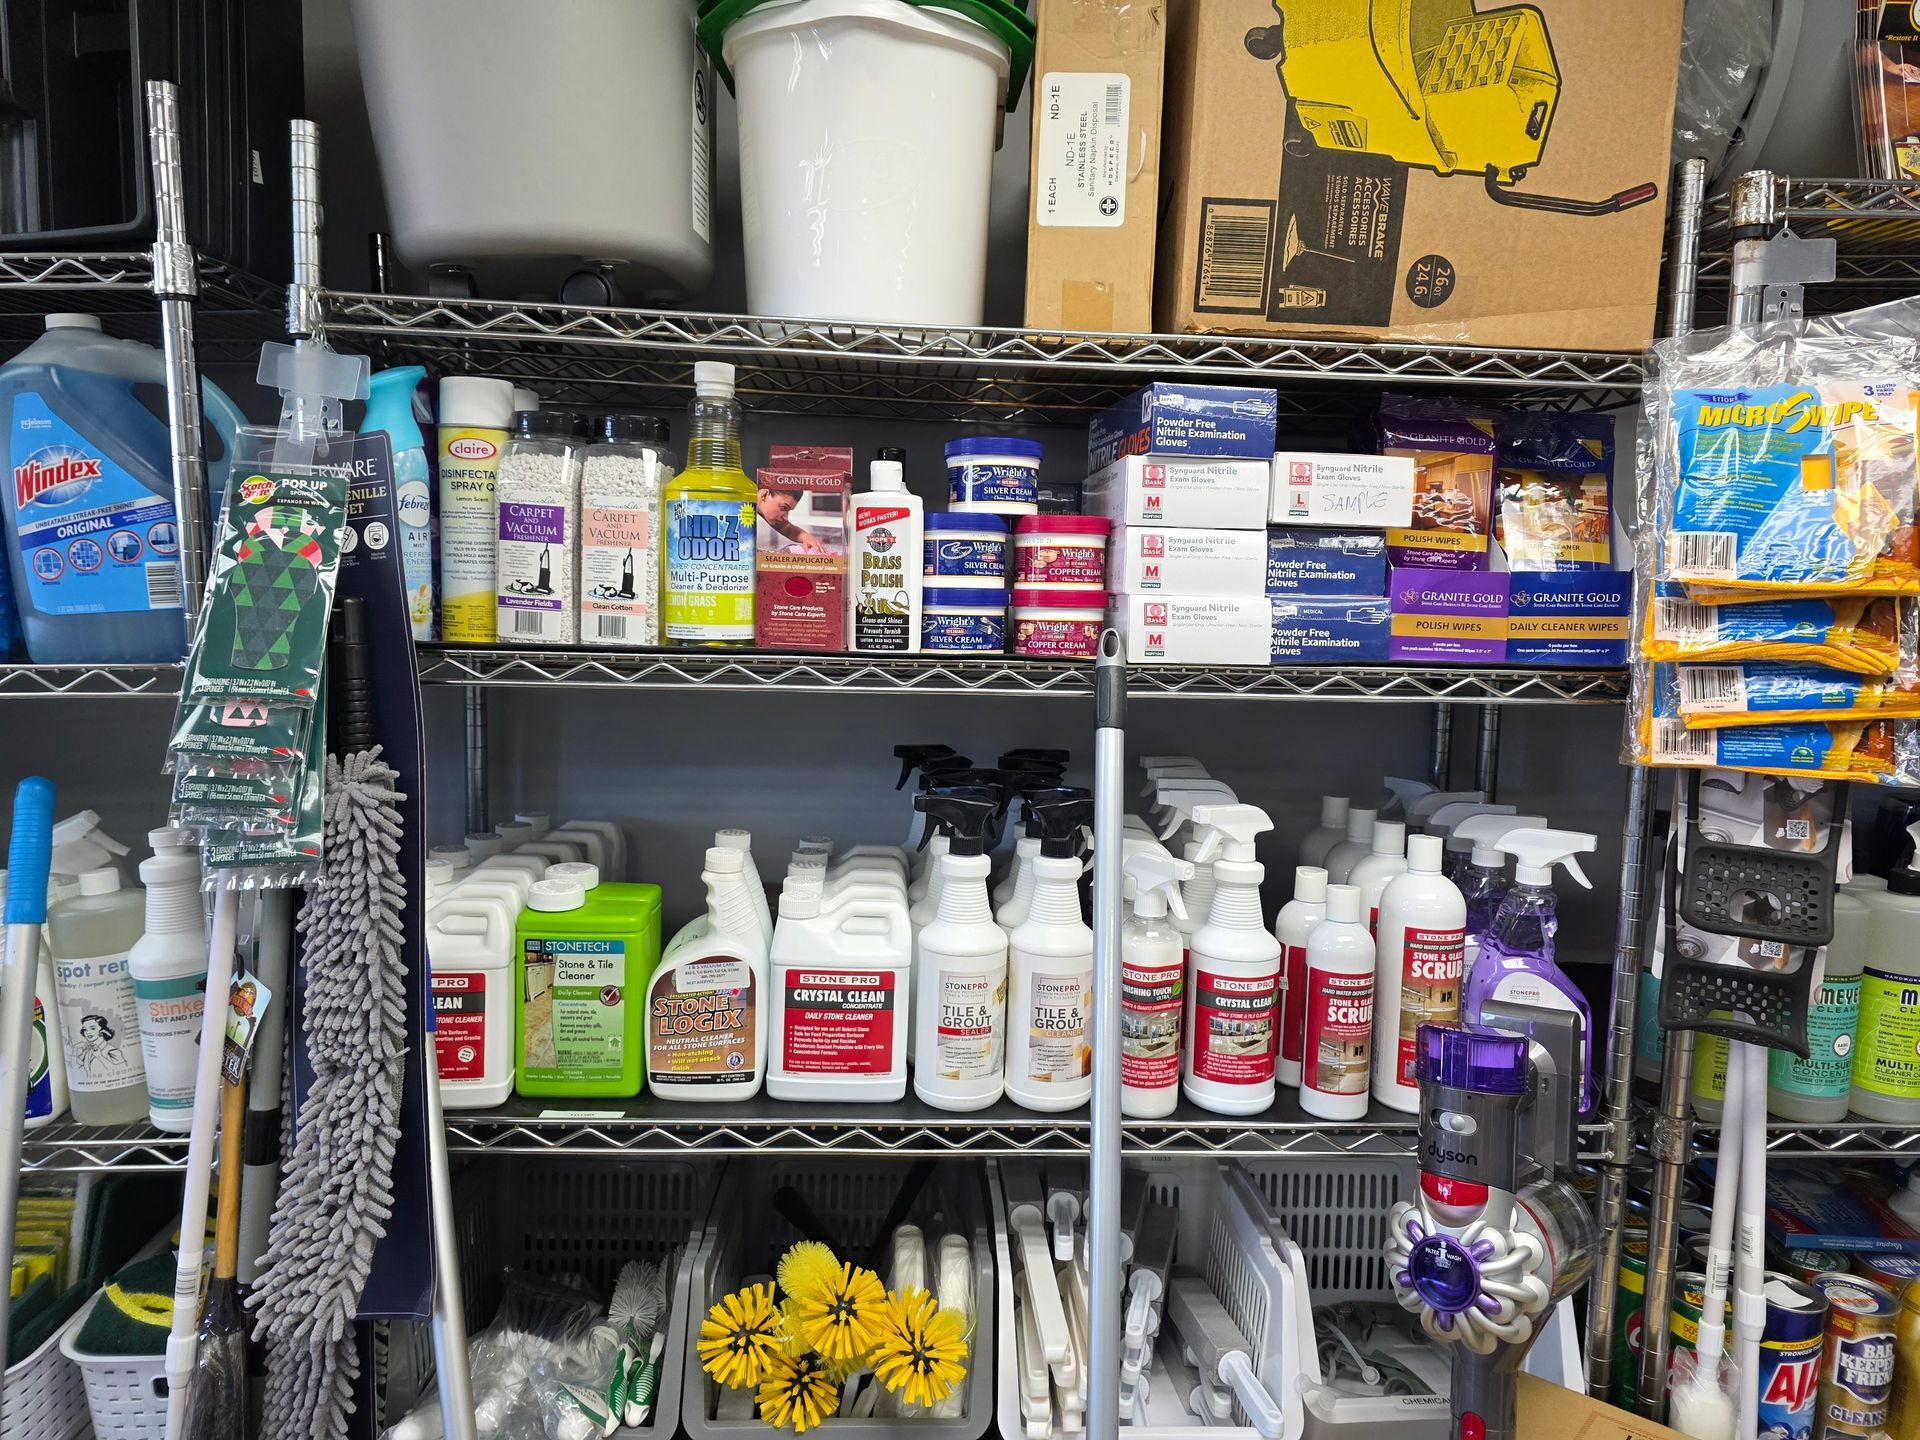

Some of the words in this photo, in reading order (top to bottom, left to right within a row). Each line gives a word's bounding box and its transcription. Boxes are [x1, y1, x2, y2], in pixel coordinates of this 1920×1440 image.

[1051, 85, 1060, 119] ND-1E
[1090, 102, 1099, 134] Disposal
[1080, 111, 1088, 138] STEEL
[1066, 133, 1076, 166] ND-1E
[1078, 140, 1087, 188] STAINLESS
[1088, 166, 1097, 197] Sanitary
[1338, 196, 1346, 236] SEPARATELY
[1349, 177, 1362, 245] ACCESSOIRES
[1359, 177, 1372, 246] ACCESSORIES
[1157, 417, 1193, 430] Powder
[1195, 419, 1216, 429] Free
[1156, 427, 1185, 437] Nitrile
[1188, 429, 1246, 441] Examination
[455, 443, 488, 454] claire
[1156, 437, 1188, 448] Gloves
[993, 467, 1027, 478] Wright's
[1207, 467, 1237, 475] Nitrile
[1316, 465, 1351, 473] Synguard
[1353, 464, 1383, 473] Nitrile
[13, 457, 101, 510] Windex
[240, 481, 273, 493] Scotch
[282, 479, 306, 488] POP
[312, 481, 327, 490] UP
[451, 481, 483, 491] SPRAY
[777, 477, 814, 485] GRANITE
[816, 478, 841, 486] GOLD
[1010, 487, 1032, 496] CREAM
[1147, 496, 1160, 507] M
[1297, 494, 1304, 504] L
[1323, 491, 1388, 514] SAMPLE
[35, 515, 72, 529] UNBEATABLE
[73, 506, 112, 522] STREAK-FREE
[113, 501, 135, 512] SHINE!
[509, 506, 554, 518] CARPET
[592, 511, 637, 524] CARPET
[858, 511, 871, 520] NEW!
[859, 517, 876, 526] WORKS
[877, 510, 898, 522] FASTER!
[57, 518, 114, 538] ORIGINAL
[506, 522, 557, 535] VACUUM
[408, 532, 428, 541] AIR
[513, 534, 549, 542] FRESHENER
[589, 528, 640, 541] VACUUM
[1403, 534, 1433, 544] POLISH
[1435, 536, 1461, 545] WIPES
[678, 538, 740, 561] ODOR
[1062, 549, 1095, 559] Wright's
[765, 555, 790, 563] SEALER
[792, 556, 834, 564] APPLICATOR
[863, 552, 902, 570] BRASS
[691, 563, 749, 571] CONCENTRATED
[671, 571, 748, 583] Multi-Purpose
[861, 570, 903, 588] POLISH
[671, 583, 694, 591] Cleaner
[506, 598, 532, 606] Lavender
[533, 599, 553, 607] Fields
[1421, 591, 1470, 602] GRANITE
[1473, 593, 1503, 603] GOLD
[1534, 593, 1580, 602] GRANITE
[1583, 594, 1620, 603] GOLD
[1038, 621, 1075, 633] Wright's
[1416, 621, 1449, 630] POLISH
[1453, 623, 1481, 631] WIPES
[1510, 623, 1538, 631] DAILY
[1541, 623, 1585, 631] CLEANER
[957, 636, 983, 644] CREAM
[546, 942, 609, 951] STONETECH
[558, 960, 584, 969] Stone
[588, 960, 595, 969] &
[598, 960, 614, 969] Tile
[1412, 961, 1463, 979] SCRUB
[57, 963, 91, 982] spot
[558, 971, 594, 980] Cleaner
[1124, 970, 1157, 980] STONE
[1161, 970, 1179, 978] PRO
[1038, 984, 1080, 992] STONEPRO
[1216, 980, 1252, 989] STONE
[1257, 981, 1272, 989] PRO
[794, 989, 843, 1002] CRYSTAL
[847, 991, 885, 1002] CLEAN
[1883, 990, 1899, 998] Mrs.
[653, 995, 729, 1016] STONE
[1216, 997, 1250, 1008] CRYSTAL
[1253, 997, 1272, 1008] CLEAN
[943, 1005, 974, 1017] TILE
[979, 1006, 987, 1015] &
[1035, 1007, 1066, 1018] TILE
[1072, 1008, 1078, 1018] &
[660, 1009, 745, 1036] LOGIX
[942, 1015, 992, 1028] GROUT
[1035, 1018, 1083, 1030] GROUT
[961, 1028, 990, 1036] SEALER
[1046, 1029, 1081, 1037] CLEANER
[666, 1037, 699, 1045] NEUTRAL
[701, 1033, 734, 1042] CLEANER
[708, 1038, 745, 1047] SURFACES
[1875, 1067, 1913, 1077] CLEANER
[1874, 1075, 1895, 1083] TOUGH
[1427, 1144, 1478, 1166] dyson
[1425, 1247, 1440, 1257] FILTER
[1446, 1253, 1462, 1261] WASH
[1864, 1344, 1893, 1358] BAR
